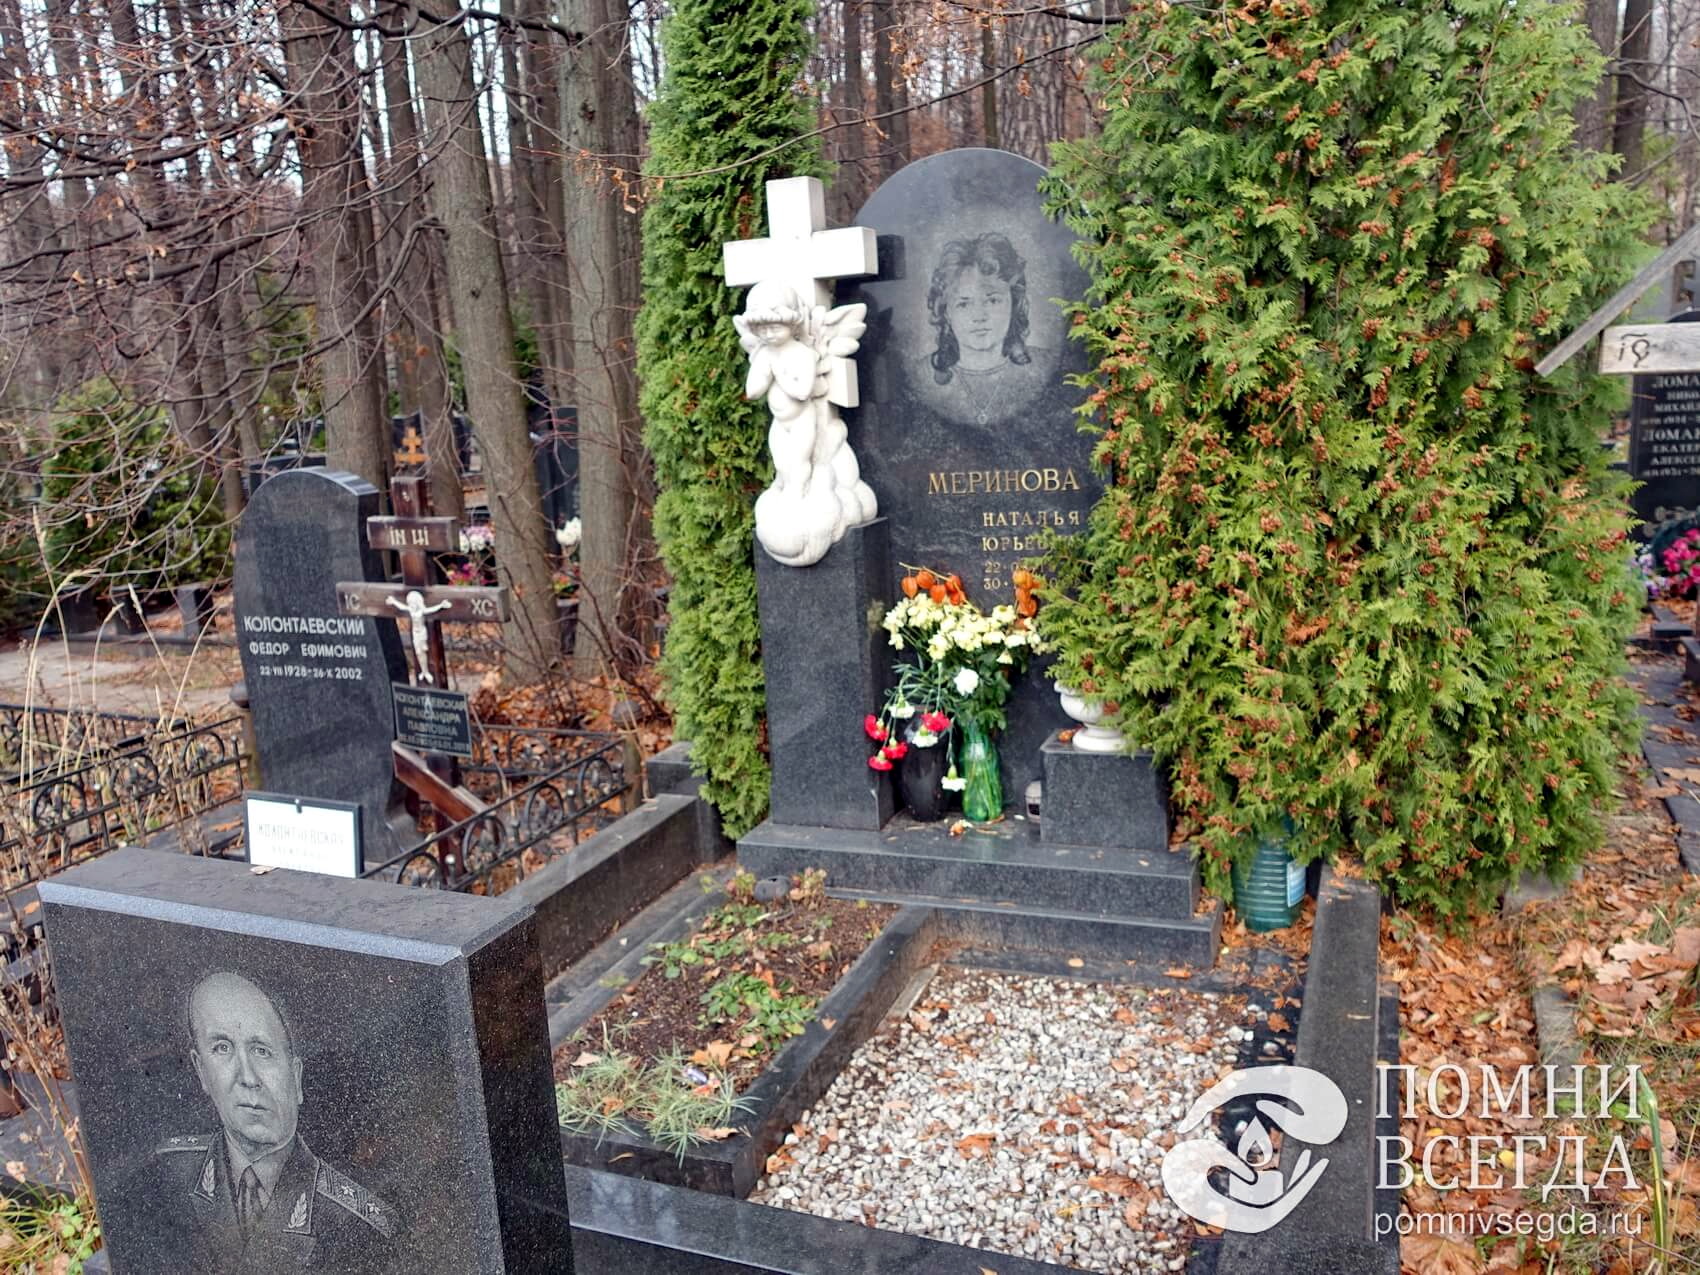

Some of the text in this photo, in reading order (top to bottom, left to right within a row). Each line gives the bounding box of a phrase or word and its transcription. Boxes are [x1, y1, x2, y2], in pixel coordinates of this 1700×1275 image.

[928, 467, 1080, 495] МЕРИНОВА
[983, 510, 1080, 528] НАТАЛЬЯ
[243, 615, 365, 636] КОЛОНТАЕВСКИЙ
[249, 641, 368, 659] ФЕДОР ЕФИМОВИЧ
